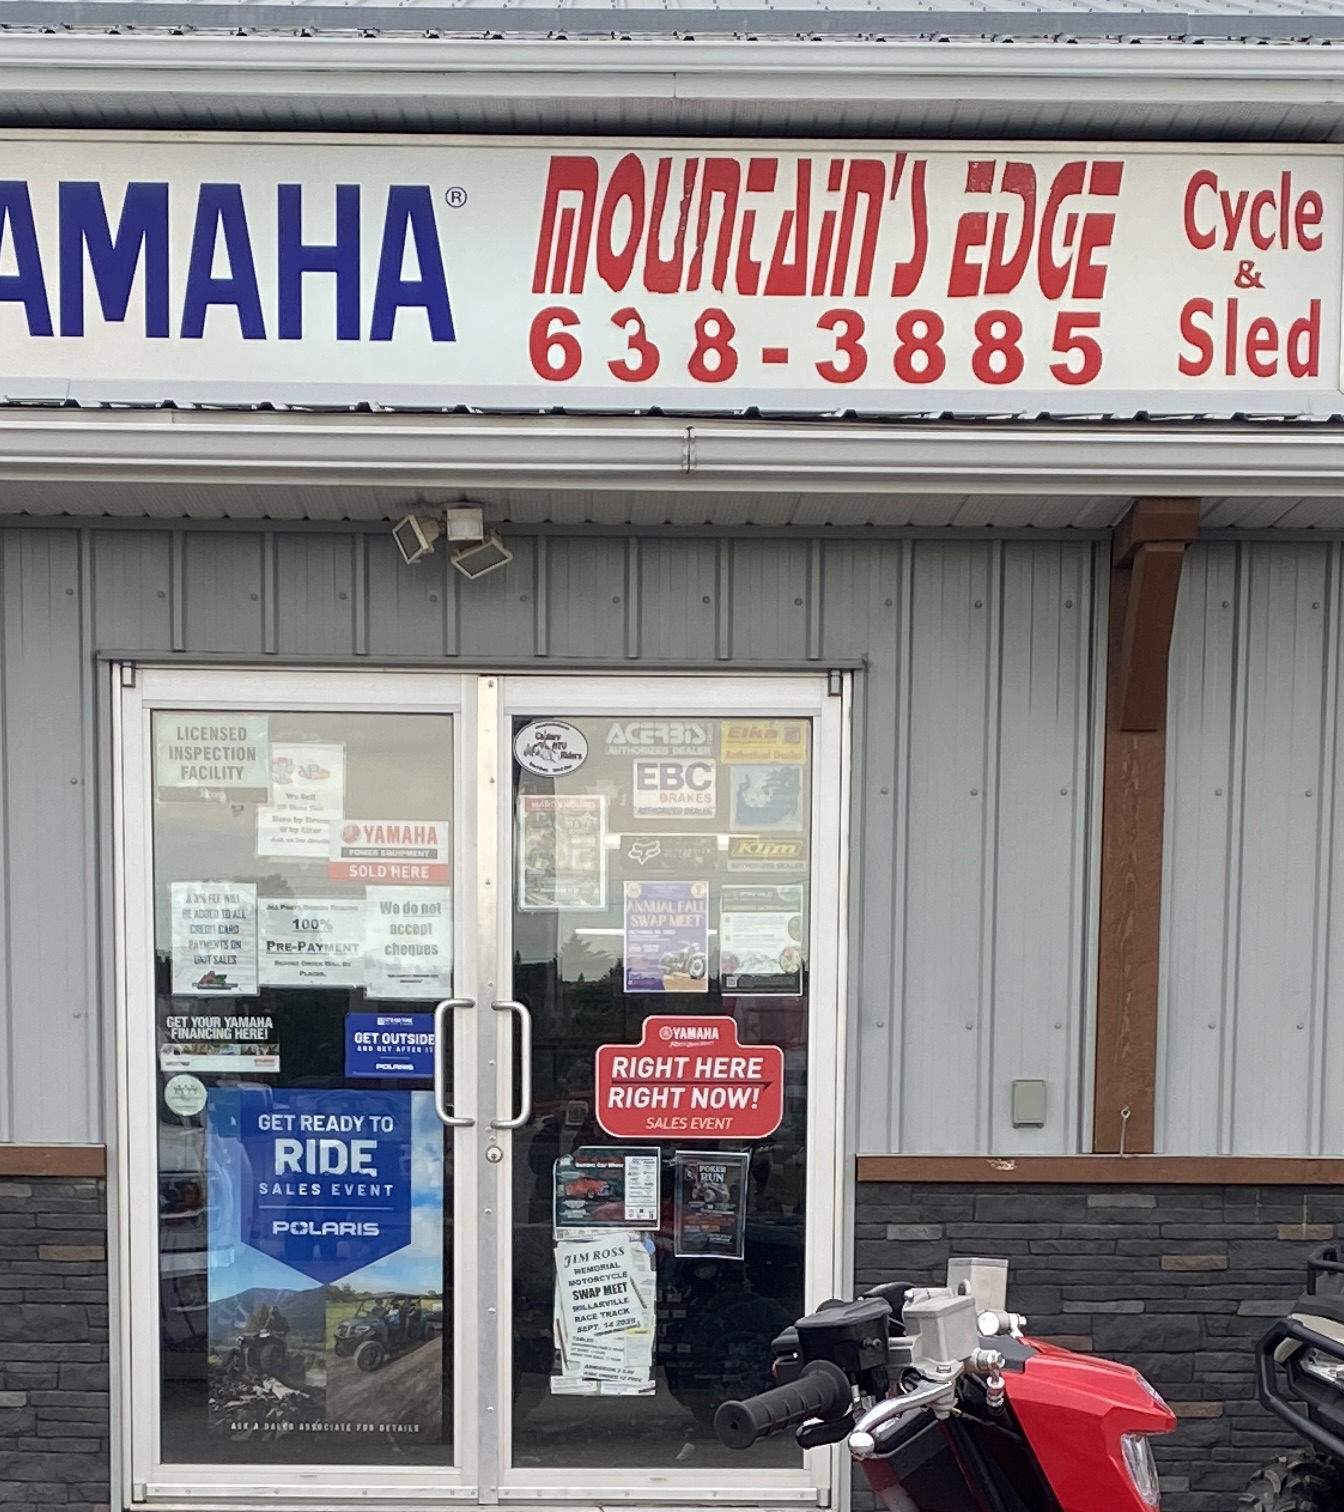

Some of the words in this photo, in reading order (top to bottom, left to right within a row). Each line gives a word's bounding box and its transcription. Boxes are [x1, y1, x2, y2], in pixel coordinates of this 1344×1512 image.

[1183, 169, 1324, 253] Cycle
[531, 152, 928, 298] MOUNTAIN'S
[947, 160, 1126, 300] EDGE
[1233, 260, 1265, 289] &
[1178, 297, 1321, 378] Sled
[529, 306, 1104, 386] 638-3885
[177, 726, 247, 741] LICENSED
[606, 722, 707, 744] ACERBIS
[168, 746, 256, 761] INSPECTION
[607, 747, 669, 755] AUTHORIZED
[672, 747, 710, 755] DEALER
[181, 766, 244, 780] FACILITY
[637, 762, 712, 791] EBC
[659, 793, 712, 804] BRAKES
[363, 825, 438, 845] YAMAHA
[349, 865, 387, 878] SOLD
[390, 865, 430, 878] HERE
[380, 901, 400, 915] We
[402, 901, 419, 915] do
[421, 902, 442, 915] not
[626, 900, 676, 913] ANNUAL
[678, 900, 705, 913] FALL
[292, 918, 333, 930] 100%
[631, 914, 667, 927] SWAP
[669, 914, 702, 927] MEET
[390, 923, 433, 937] accept
[384, 943, 439, 957] cheques
[213, 955, 237, 964] SALES
[166, 1016, 187, 1028] GET
[190, 1016, 221, 1028] YOUR
[223, 1016, 273, 1029] YAMAHA
[170, 1028, 232, 1040] FINANCING
[234, 1028, 269, 1040] HERE!
[354, 1031, 380, 1045] GET
[381, 1032, 435, 1045] OUTSIDE
[672, 1027, 720, 1040] YAMAHA
[612, 1057, 689, 1079] RIGHT
[694, 1057, 764, 1079] HERE
[608, 1088, 686, 1109] RIGHT
[690, 1088, 760, 1109] NOW!
[258, 1115, 297, 1131] GET
[300, 1115, 366, 1132] READY
[369, 1116, 394, 1132] TO
[646, 1117, 688, 1130] SALES
[690, 1117, 733, 1130] EVENT
[275, 1138, 378, 1177] RIDE
[259, 1183, 322, 1196] SALES
[331, 1184, 394, 1197] EVENT
[272, 1221, 380, 1236] POLARIS
[592, 1246, 625, 1262] ROSS
[574, 1262, 621, 1275] MEMORIAL
[568, 1271, 628, 1286] MOTORCYCLE
[572, 1287, 601, 1301] SWAP
[603, 1282, 628, 1296] MEET
[574, 1313, 598, 1323] RACE
[600, 1308, 630, 1318] TRACK
[264, 1423, 295, 1431] SALES
[299, 1423, 351, 1432] ASSOCIATE
[356, 1424, 374, 1432] FOR
[379, 1424, 420, 1432] DETAILS
